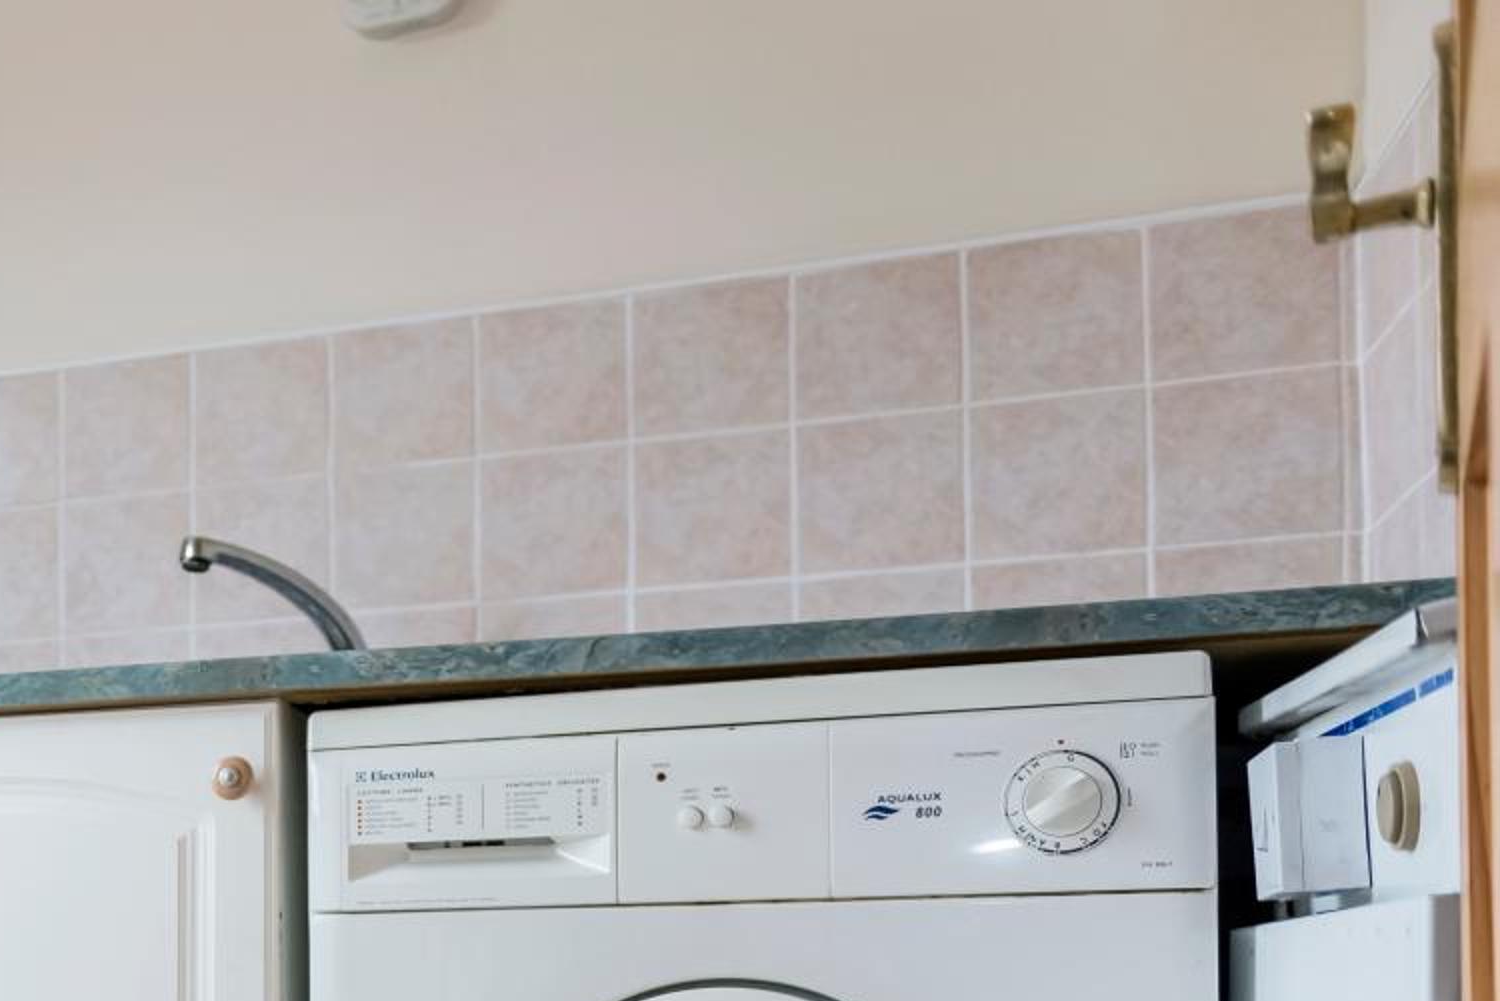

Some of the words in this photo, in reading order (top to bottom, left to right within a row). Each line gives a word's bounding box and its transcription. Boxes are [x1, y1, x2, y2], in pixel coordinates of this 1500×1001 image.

[371, 767, 435, 782] Electrolux
[877, 792, 942, 804] AQUALUX
[915, 805, 943, 818] 800
